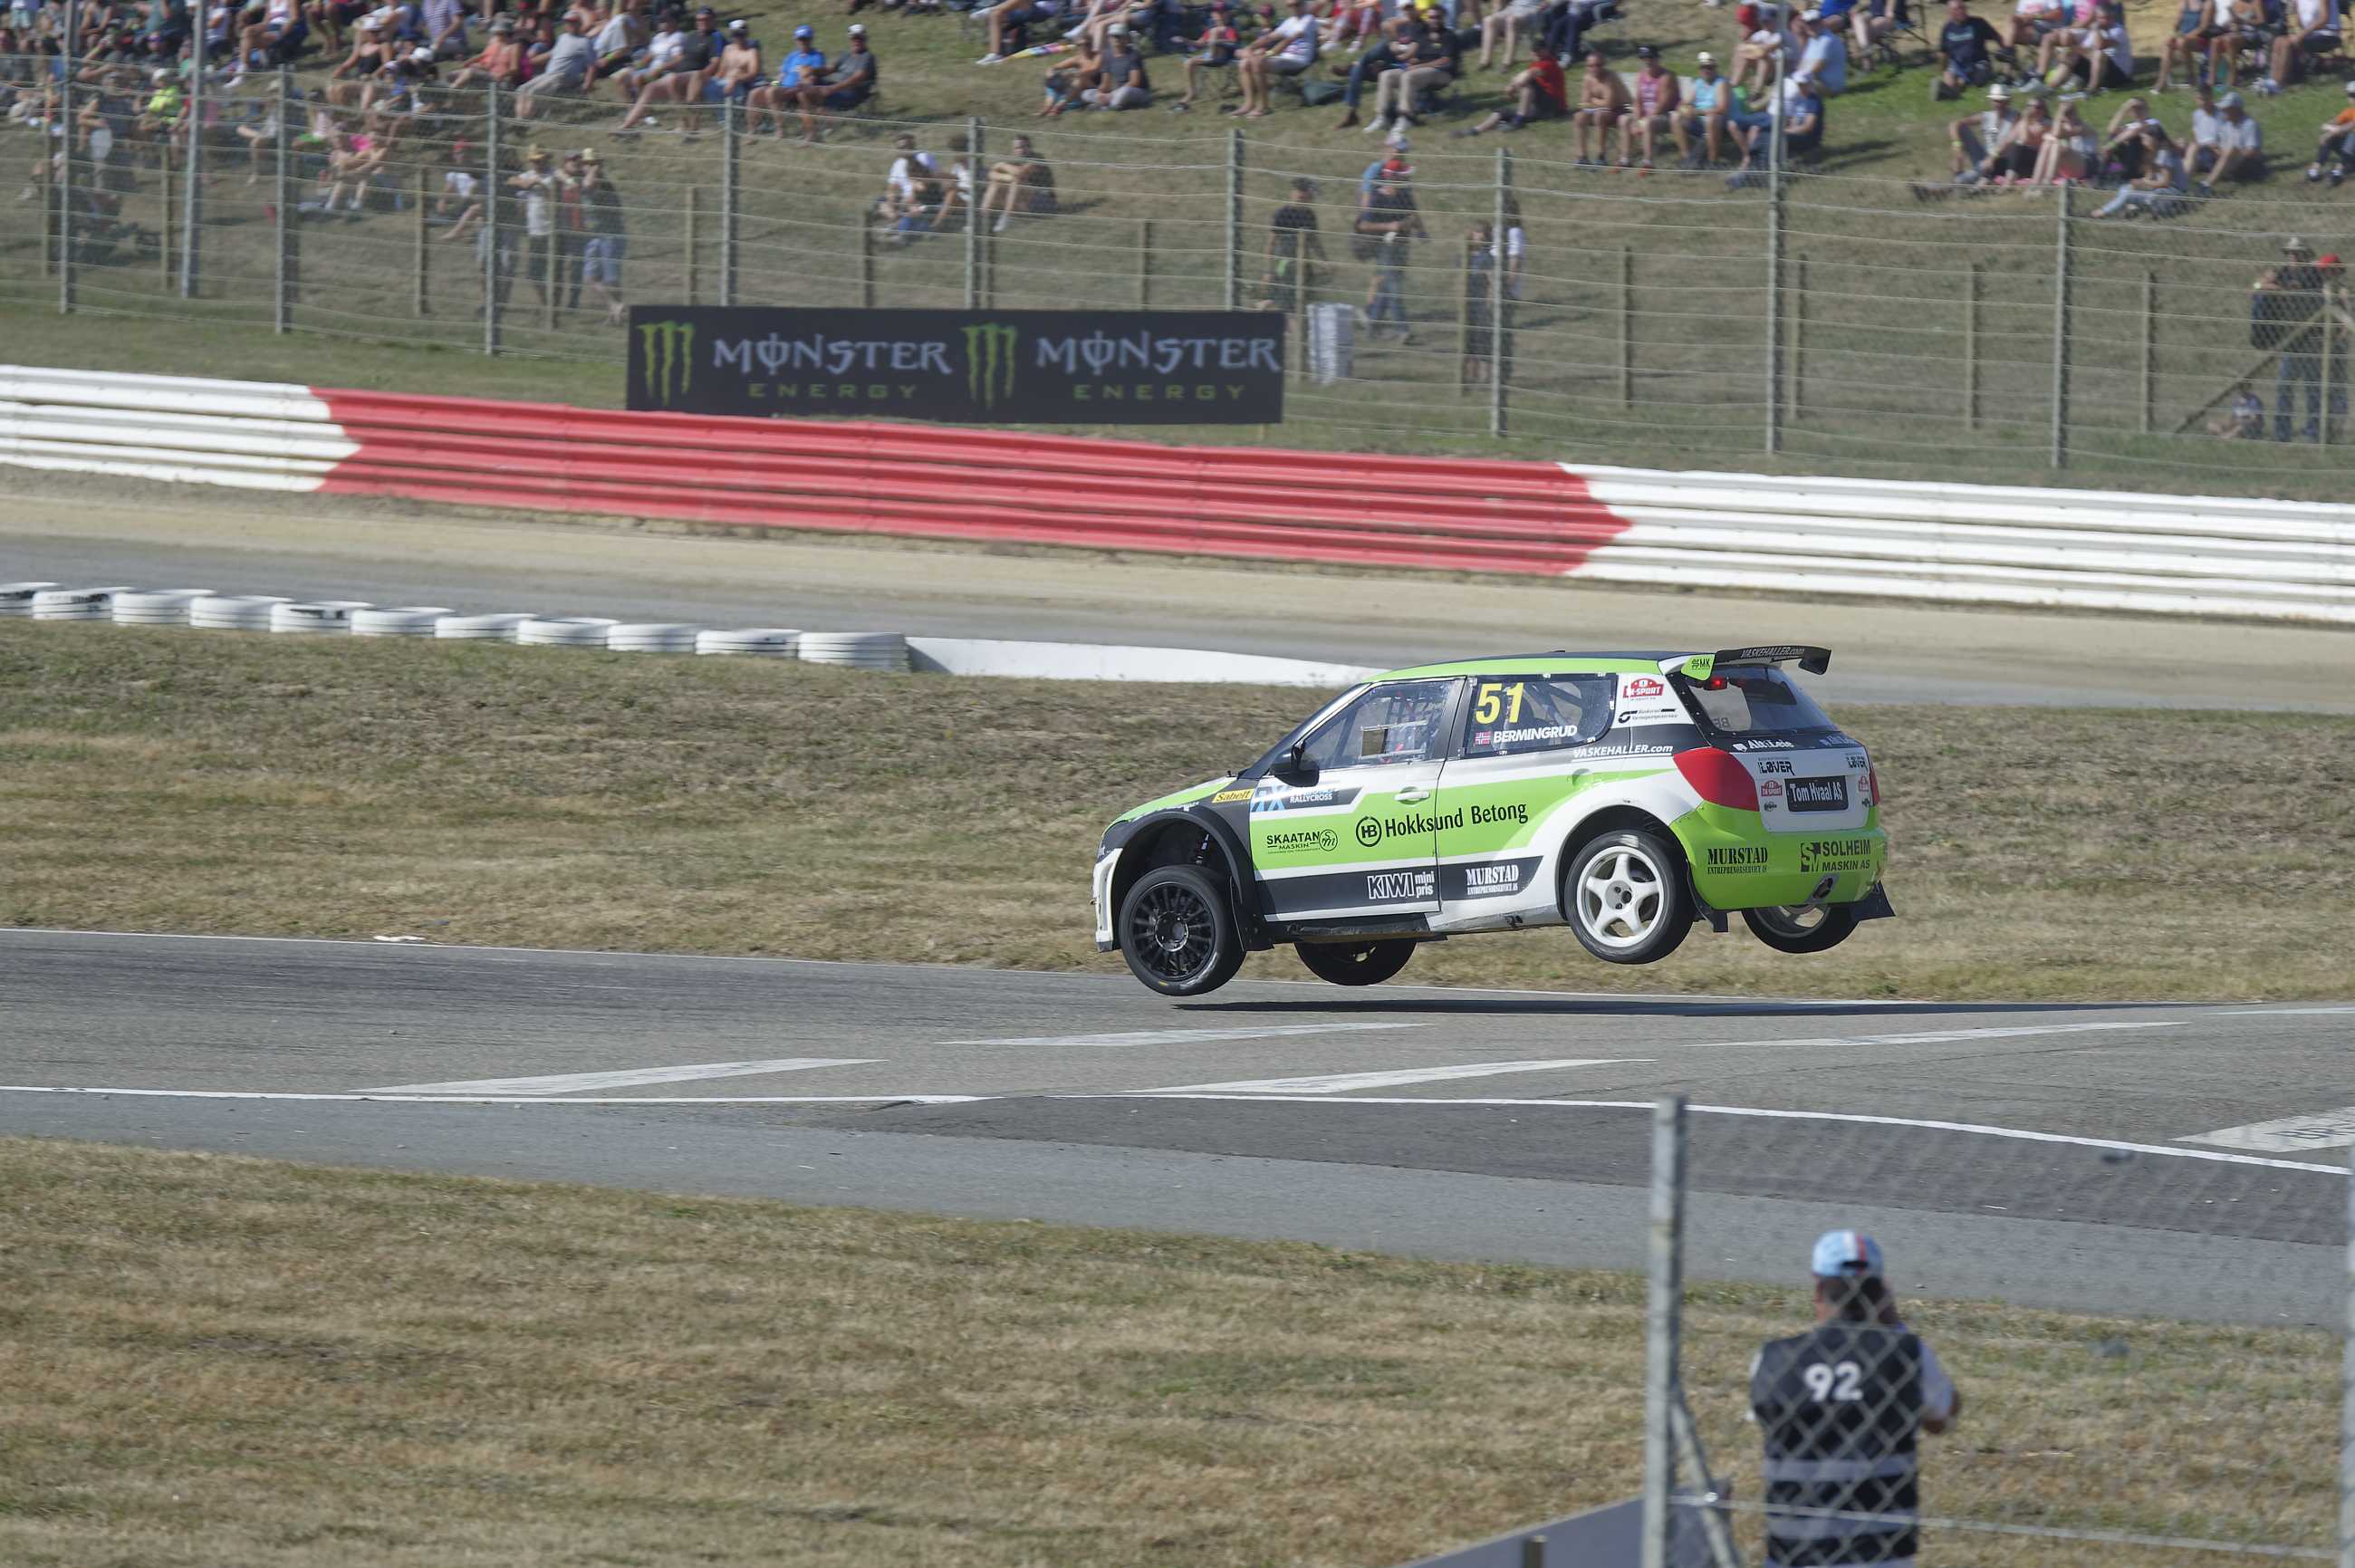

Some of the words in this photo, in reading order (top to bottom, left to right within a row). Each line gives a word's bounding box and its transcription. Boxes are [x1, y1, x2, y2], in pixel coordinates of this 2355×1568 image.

[747, 382, 917, 399] ENERGY
[1073, 383, 1246, 401] ENERGY
[1475, 682, 1524, 725] 51
[1493, 725, 1578, 744] BERMINGRUD
[1289, 793, 1333, 804] RALLYCROSS
[1789, 783, 1810, 803] Tom
[1810, 782, 1832, 802] Hvaal
[1833, 781, 1843, 801] AS
[1385, 807, 1464, 838] Hokksund
[1471, 803, 1529, 824] Betong
[1266, 831, 1321, 845] SKAATAN
[1278, 842, 1310, 851] MASKIN
[1707, 847, 1768, 865] MURSTAD
[1822, 839, 1871, 857] SOLHEIM
[1822, 860, 1858, 872] MASKIN
[1860, 859, 1870, 870] AS
[1465, 864, 1520, 886] MURSTAD
[1367, 872, 1415, 899] KIWI
[1414, 871, 1435, 885] mini
[1415, 884, 1434, 899] pris
[1803, 1361, 1863, 1401] 92
